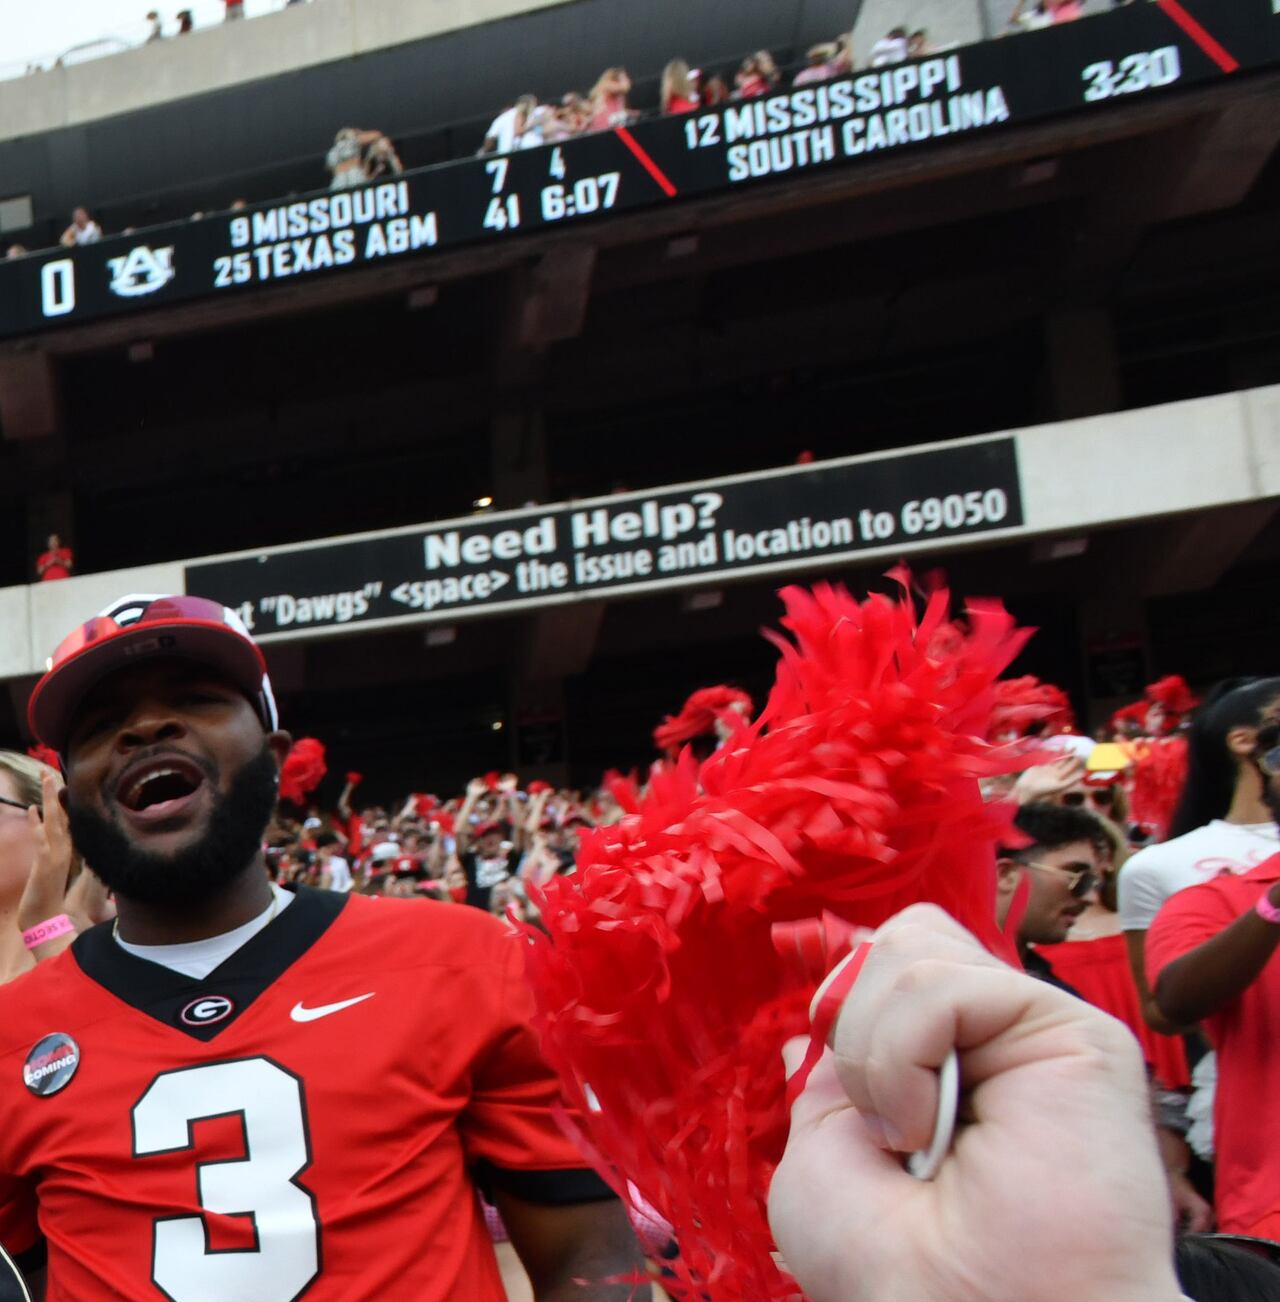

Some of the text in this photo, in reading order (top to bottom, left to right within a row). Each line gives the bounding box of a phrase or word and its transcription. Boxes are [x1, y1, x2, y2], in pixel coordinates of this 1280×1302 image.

[684, 45, 1181, 151] 12 MISSISSIPPI 3:30
[727, 86, 1010, 182] SOUTH CAROLINA
[213, 172, 621, 289] 25 TEXAS A&M 41 6:07
[230, 146, 567, 249] 9 MISSOURI 7 4
[41, 258, 76, 318] 0
[260, 581, 383, 625] "Dawgs"
[390, 570, 510, 610] <space>
[517, 559, 568, 592] the
[574, 546, 652, 584] issue
[658, 533, 718, 571] and
[723, 515, 855, 563] location
[858, 510, 895, 541] to
[900, 487, 1008, 535] 69050
[423, 492, 724, 571] Need Help?
